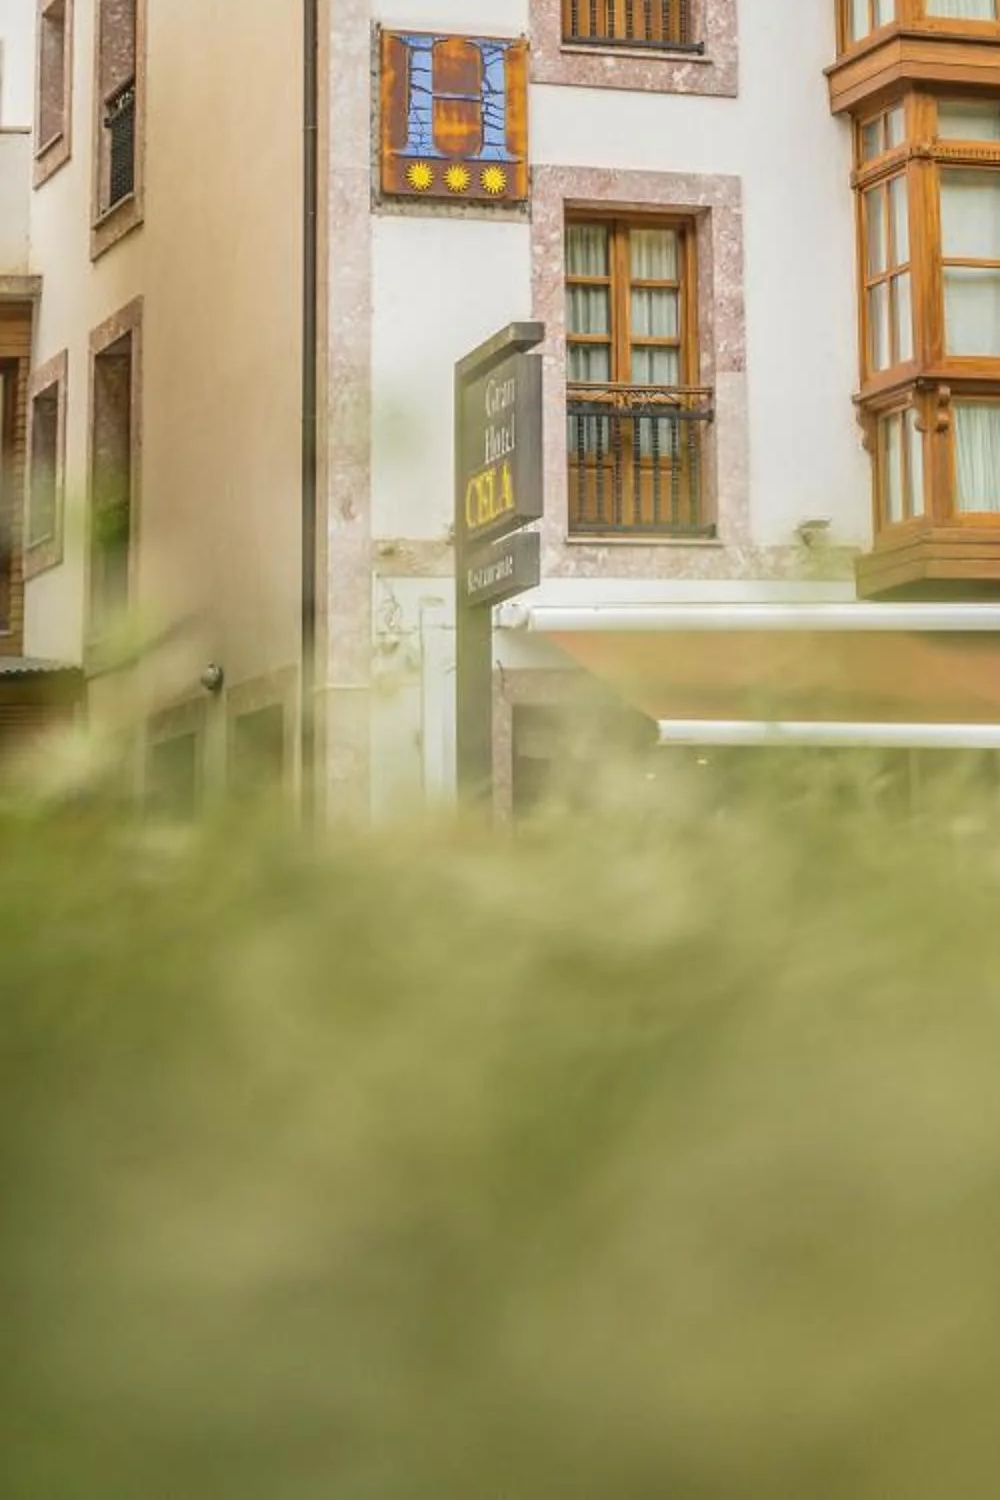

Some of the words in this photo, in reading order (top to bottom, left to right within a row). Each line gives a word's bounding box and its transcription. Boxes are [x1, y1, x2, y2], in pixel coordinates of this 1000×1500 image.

[391, 35, 523, 165] H
[485, 378, 515, 418] Gran
[484, 419, 516, 465] Hotel
[464, 460, 513, 529] CELA
